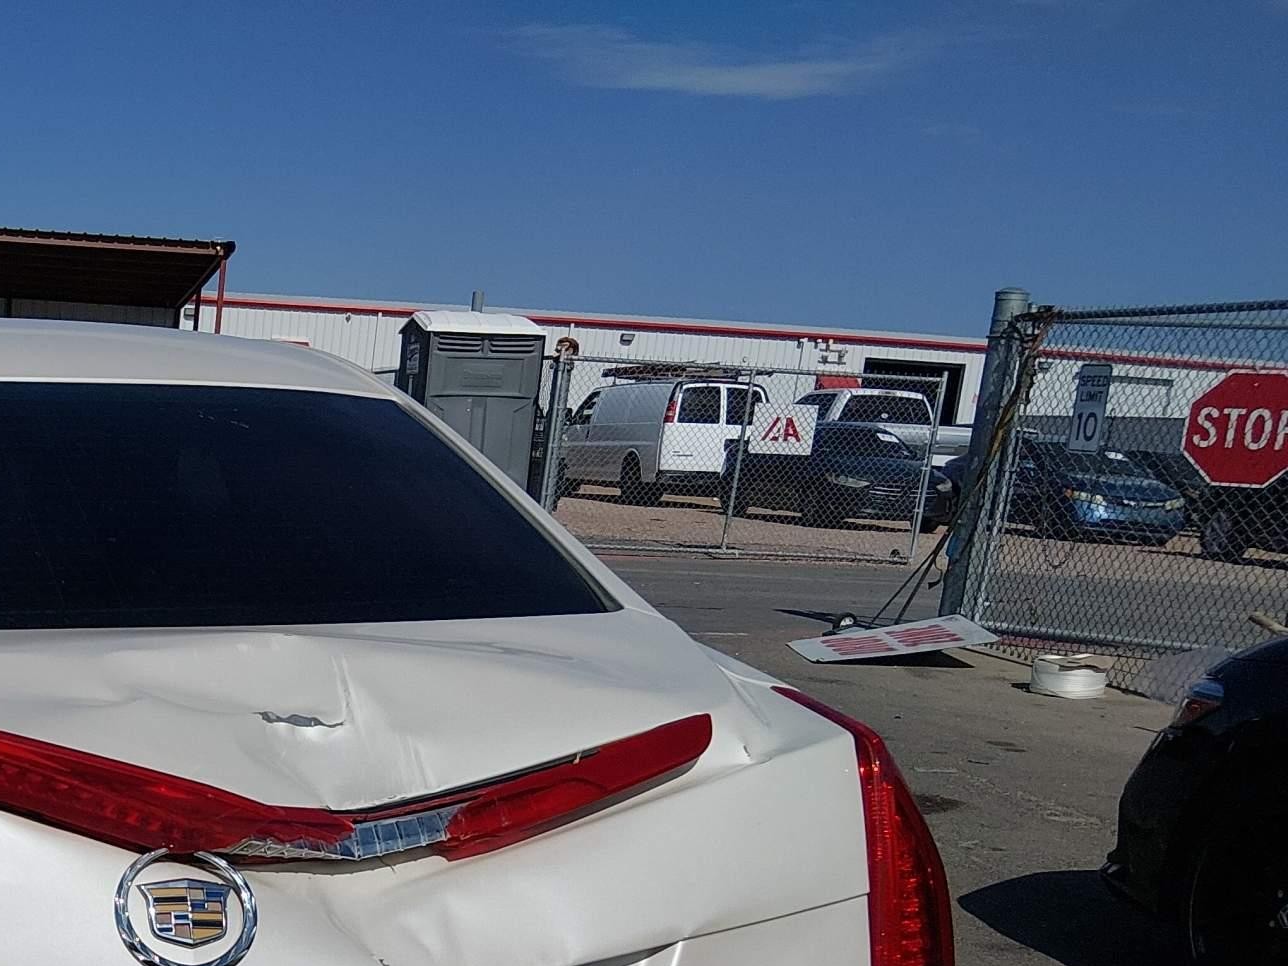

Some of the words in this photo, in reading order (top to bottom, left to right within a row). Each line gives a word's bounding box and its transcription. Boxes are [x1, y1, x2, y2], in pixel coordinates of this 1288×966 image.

[1080, 375, 1108, 387] SPEED
[1080, 390, 1104, 402] LIMIT
[1075, 412, 1098, 441] 10
